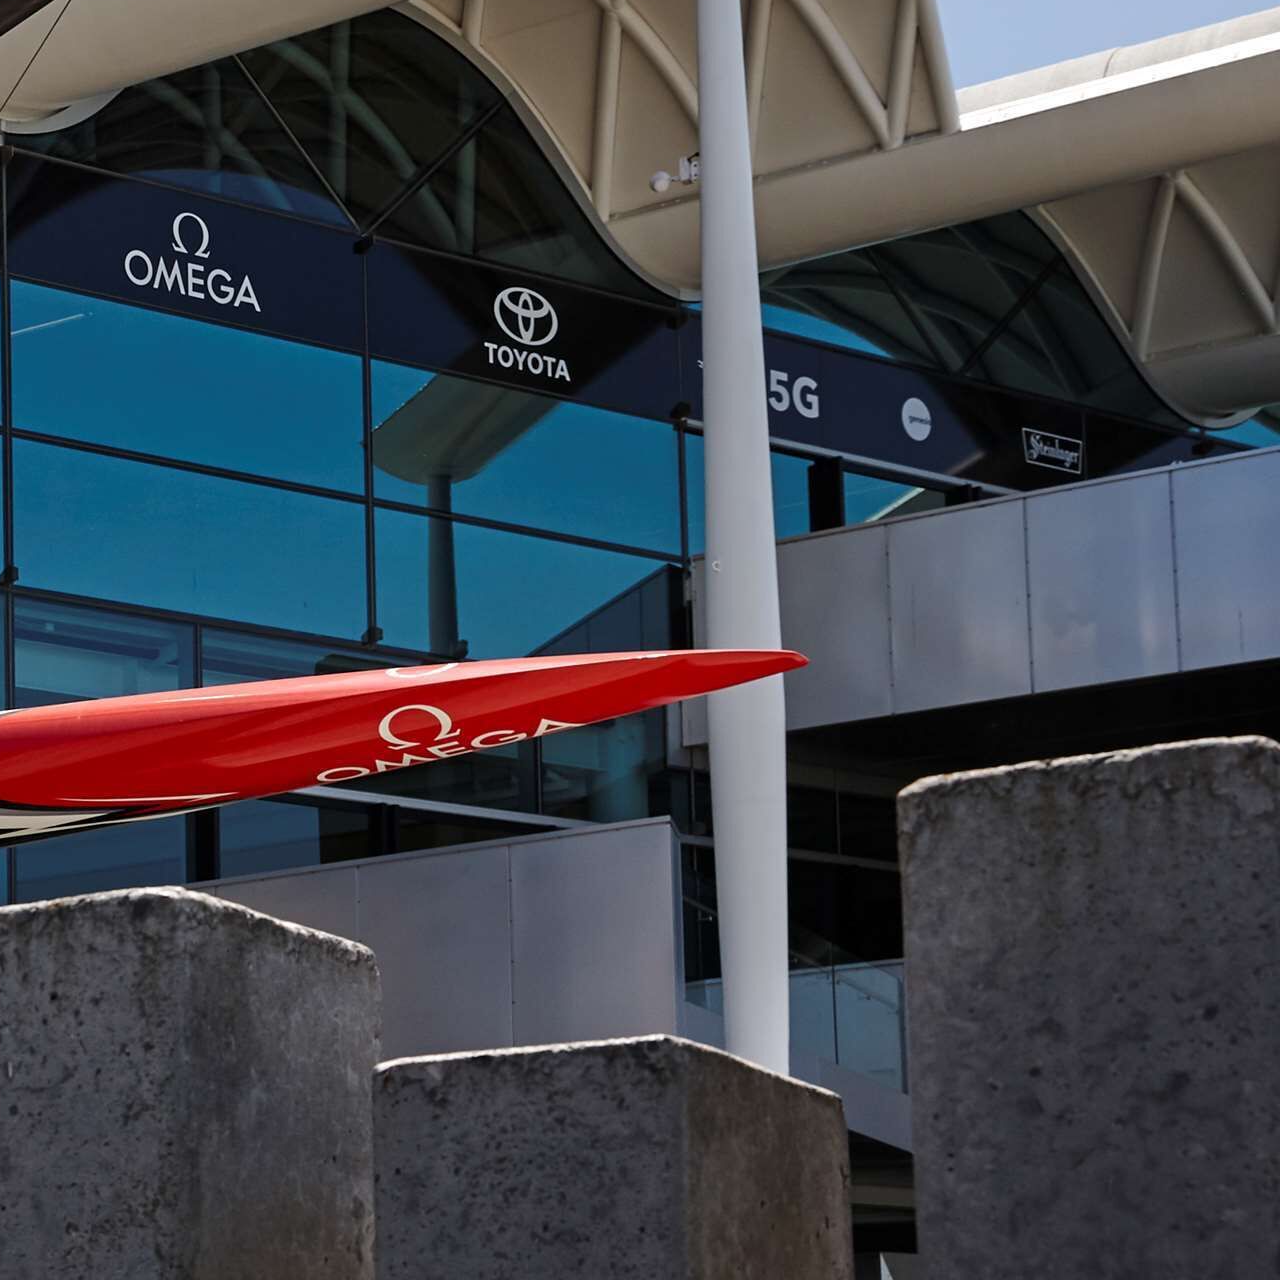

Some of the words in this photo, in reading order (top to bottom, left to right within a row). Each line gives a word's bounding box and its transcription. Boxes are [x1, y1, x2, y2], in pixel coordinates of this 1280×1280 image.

[124, 249, 262, 313] OMEGA
[483, 341, 572, 382] TOYOTA
[768, 369, 820, 419] 5G
[316, 718, 587, 783] OMEGA
